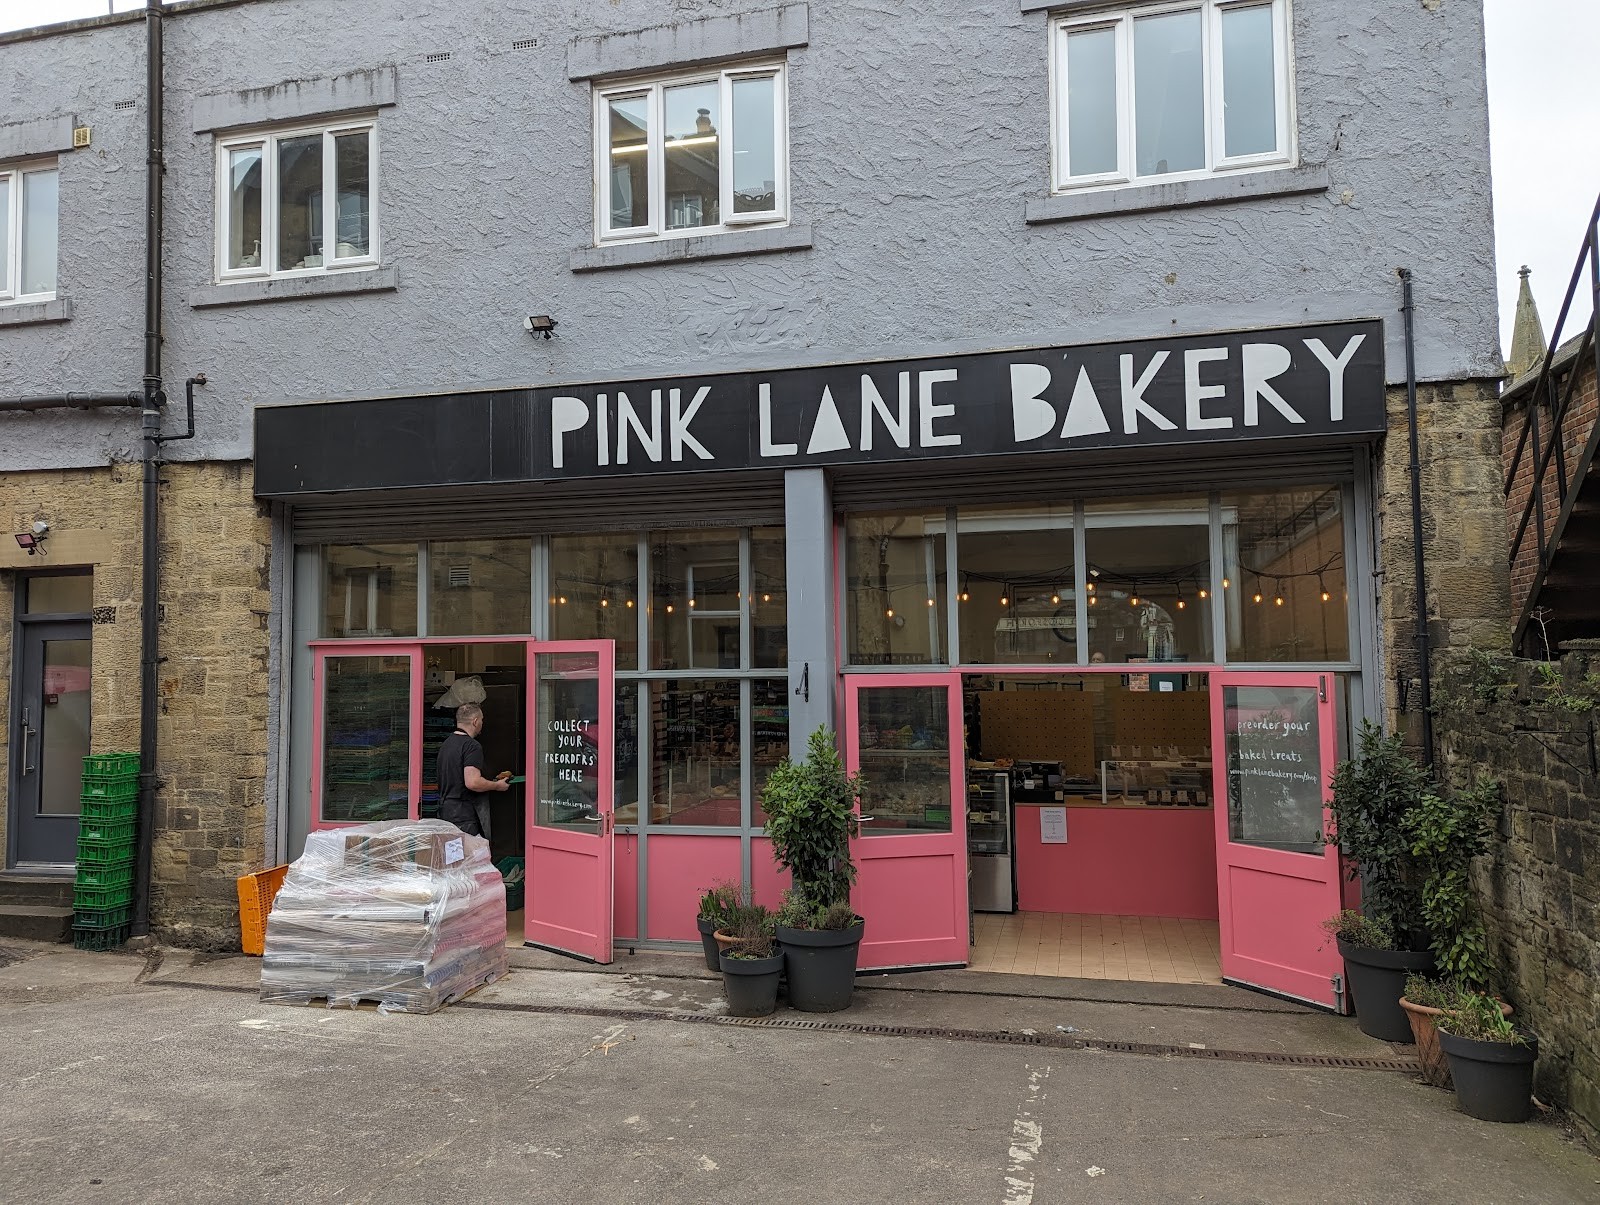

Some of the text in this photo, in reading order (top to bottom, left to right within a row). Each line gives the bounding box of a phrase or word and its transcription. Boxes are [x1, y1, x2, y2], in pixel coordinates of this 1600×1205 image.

[551, 333, 1367, 469] PINK LANE BAKERY
[548, 719, 590, 732] COLLECT
[1238, 718, 1311, 737] preorder your
[558, 734, 583, 748] YOUR
[545, 753, 594, 766] PREORDERS
[1239, 748, 1303, 763] baked treats
[559, 768, 583, 783] HERE
